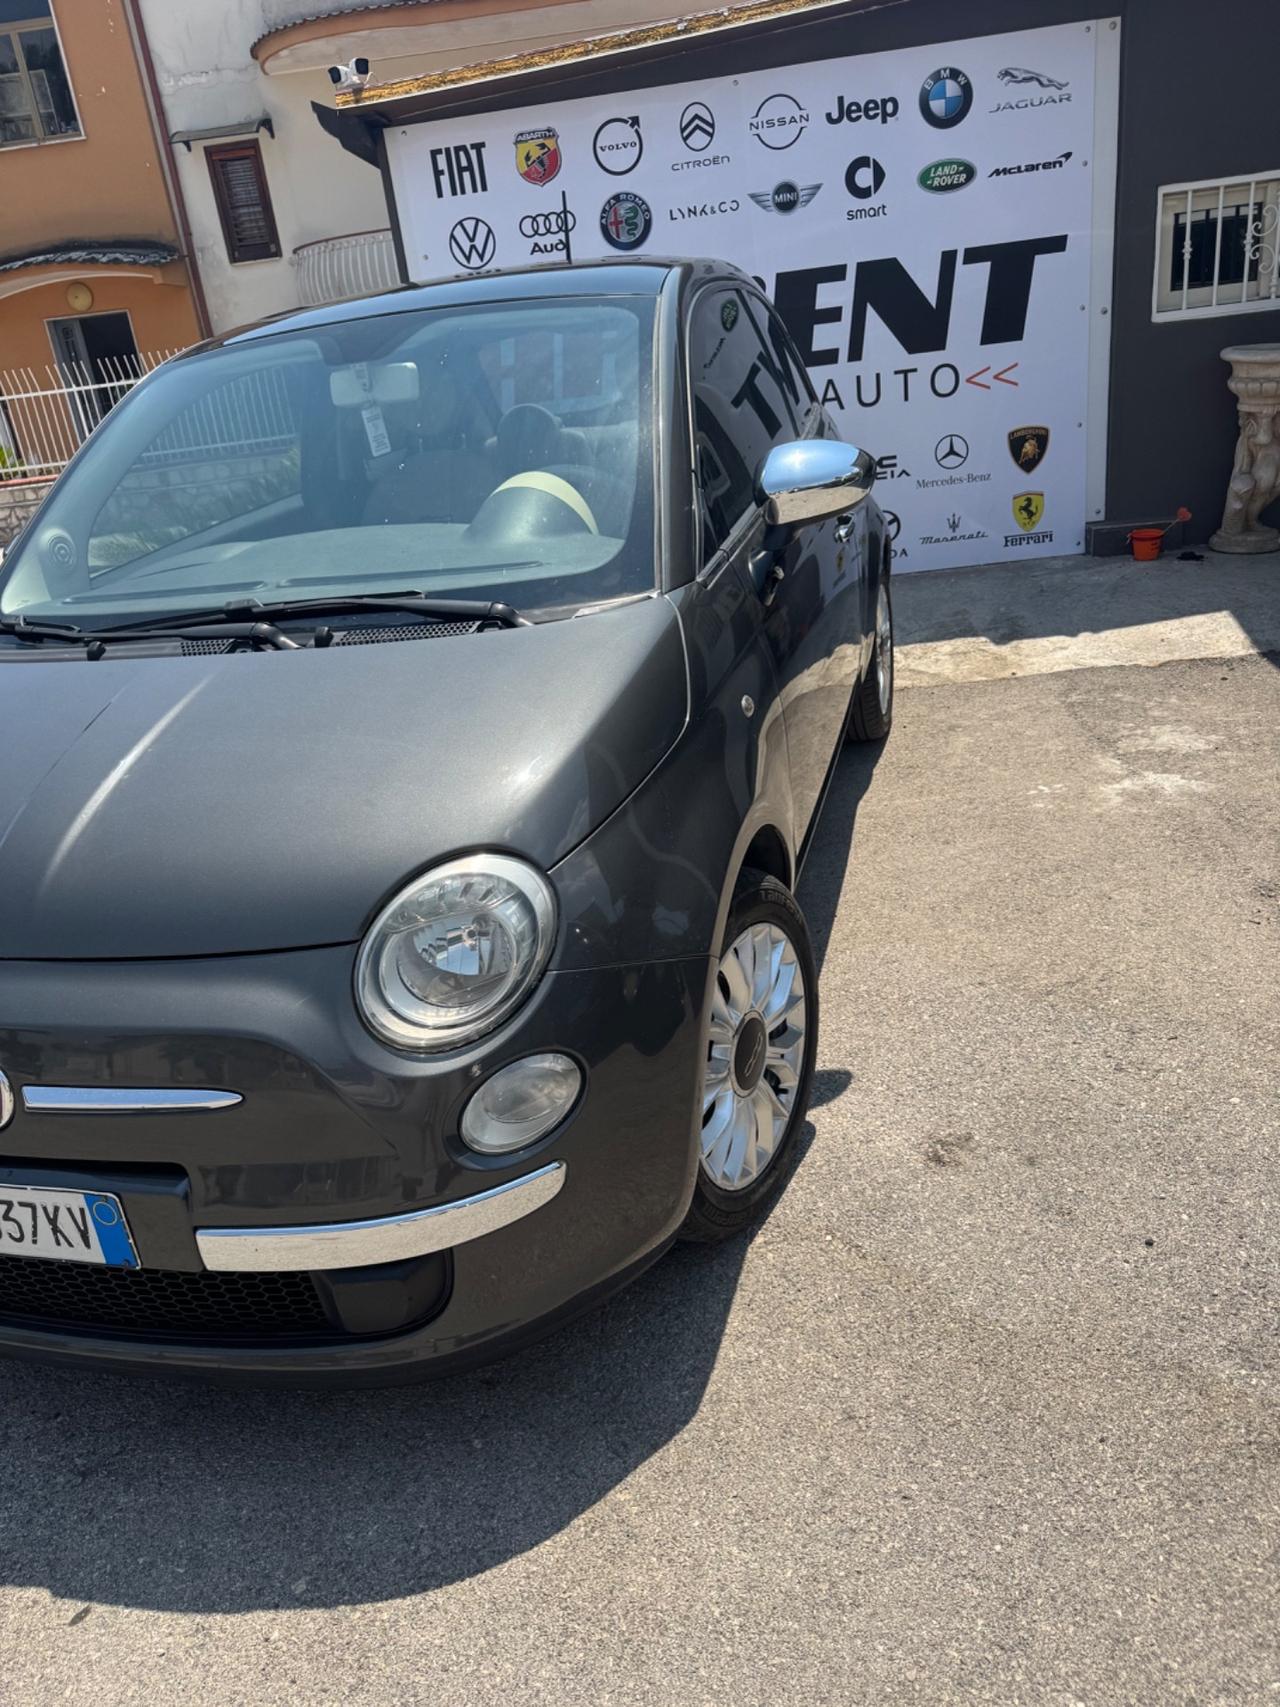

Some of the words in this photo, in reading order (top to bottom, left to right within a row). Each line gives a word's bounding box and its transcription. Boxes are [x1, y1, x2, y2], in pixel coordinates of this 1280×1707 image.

[924, 68, 968, 91] BMW
[825, 96, 899, 124] Jeep
[988, 93, 1073, 113] JAGUAR
[750, 113, 810, 131] NISSAN
[516, 130, 554, 141] ABARTH
[599, 141, 637, 152] VOLVO
[430, 142, 488, 198] FIAT
[930, 164, 957, 177] LAND
[987, 159, 1063, 178] McLaren
[932, 173, 967, 187] ROVER
[774, 192, 798, 203] MINI
[601, 199, 617, 225] ALFA
[619, 194, 650, 220] ROMEO
[846, 204, 887, 221] smart
[530, 239, 571, 255] Aud
[753, 235, 1068, 368] ENT
[822, 363, 960, 410] AUTO
[916, 472, 992, 490] Mercedes-Benz
[920, 530, 990, 545] Maserati
[1003, 530, 1053, 547] Ferrari
[0, 1200, 91, 1250] 37KV
